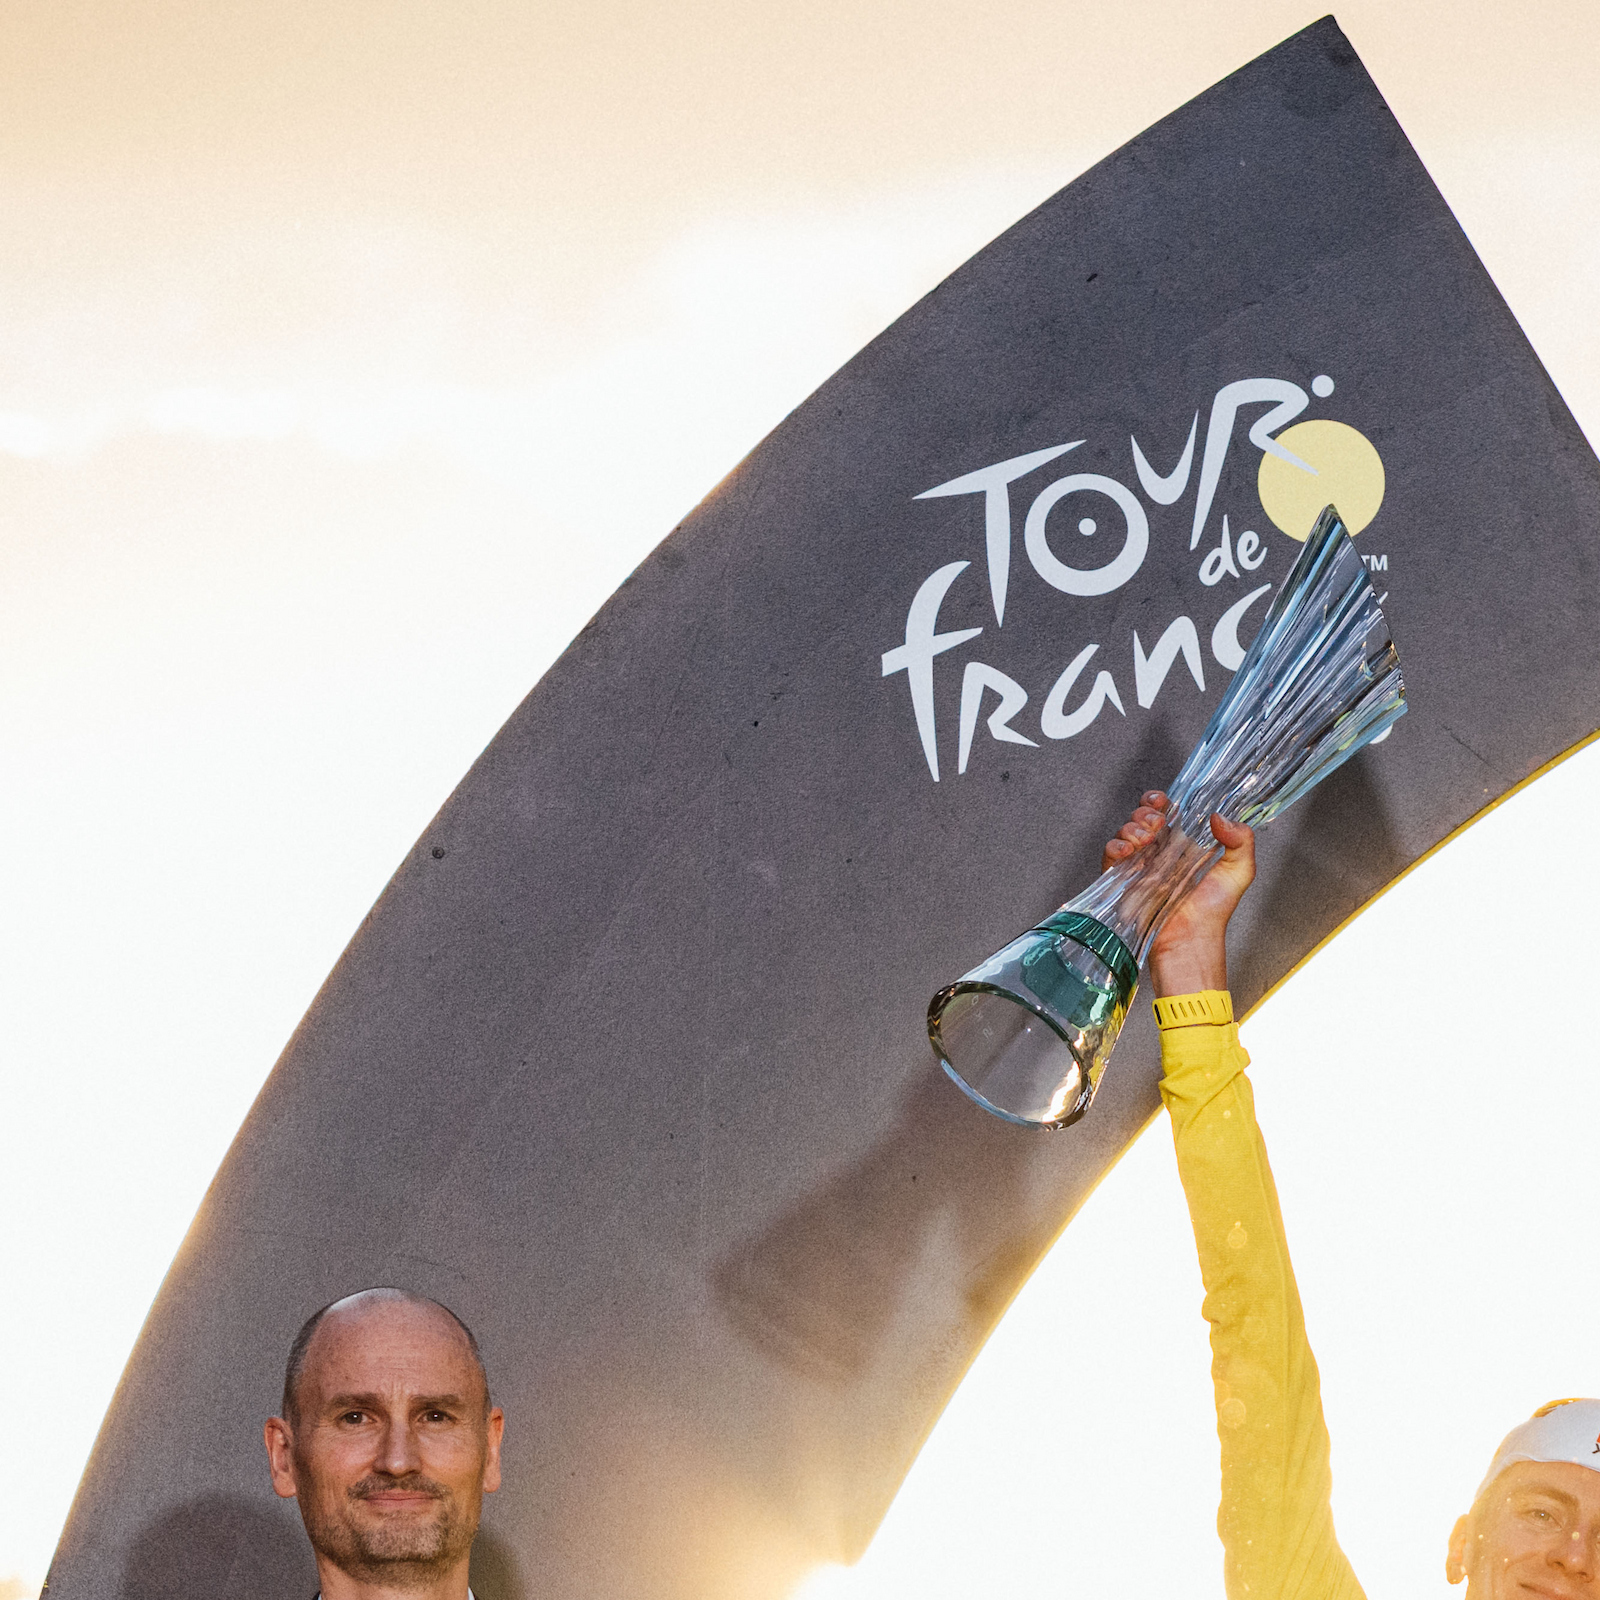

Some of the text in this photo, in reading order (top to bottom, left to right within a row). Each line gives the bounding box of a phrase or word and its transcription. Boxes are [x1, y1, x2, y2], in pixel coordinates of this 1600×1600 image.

[912, 375, 1334, 629] TOUR
[1198, 514, 1268, 587] de
[881, 561, 1388, 782] franc
